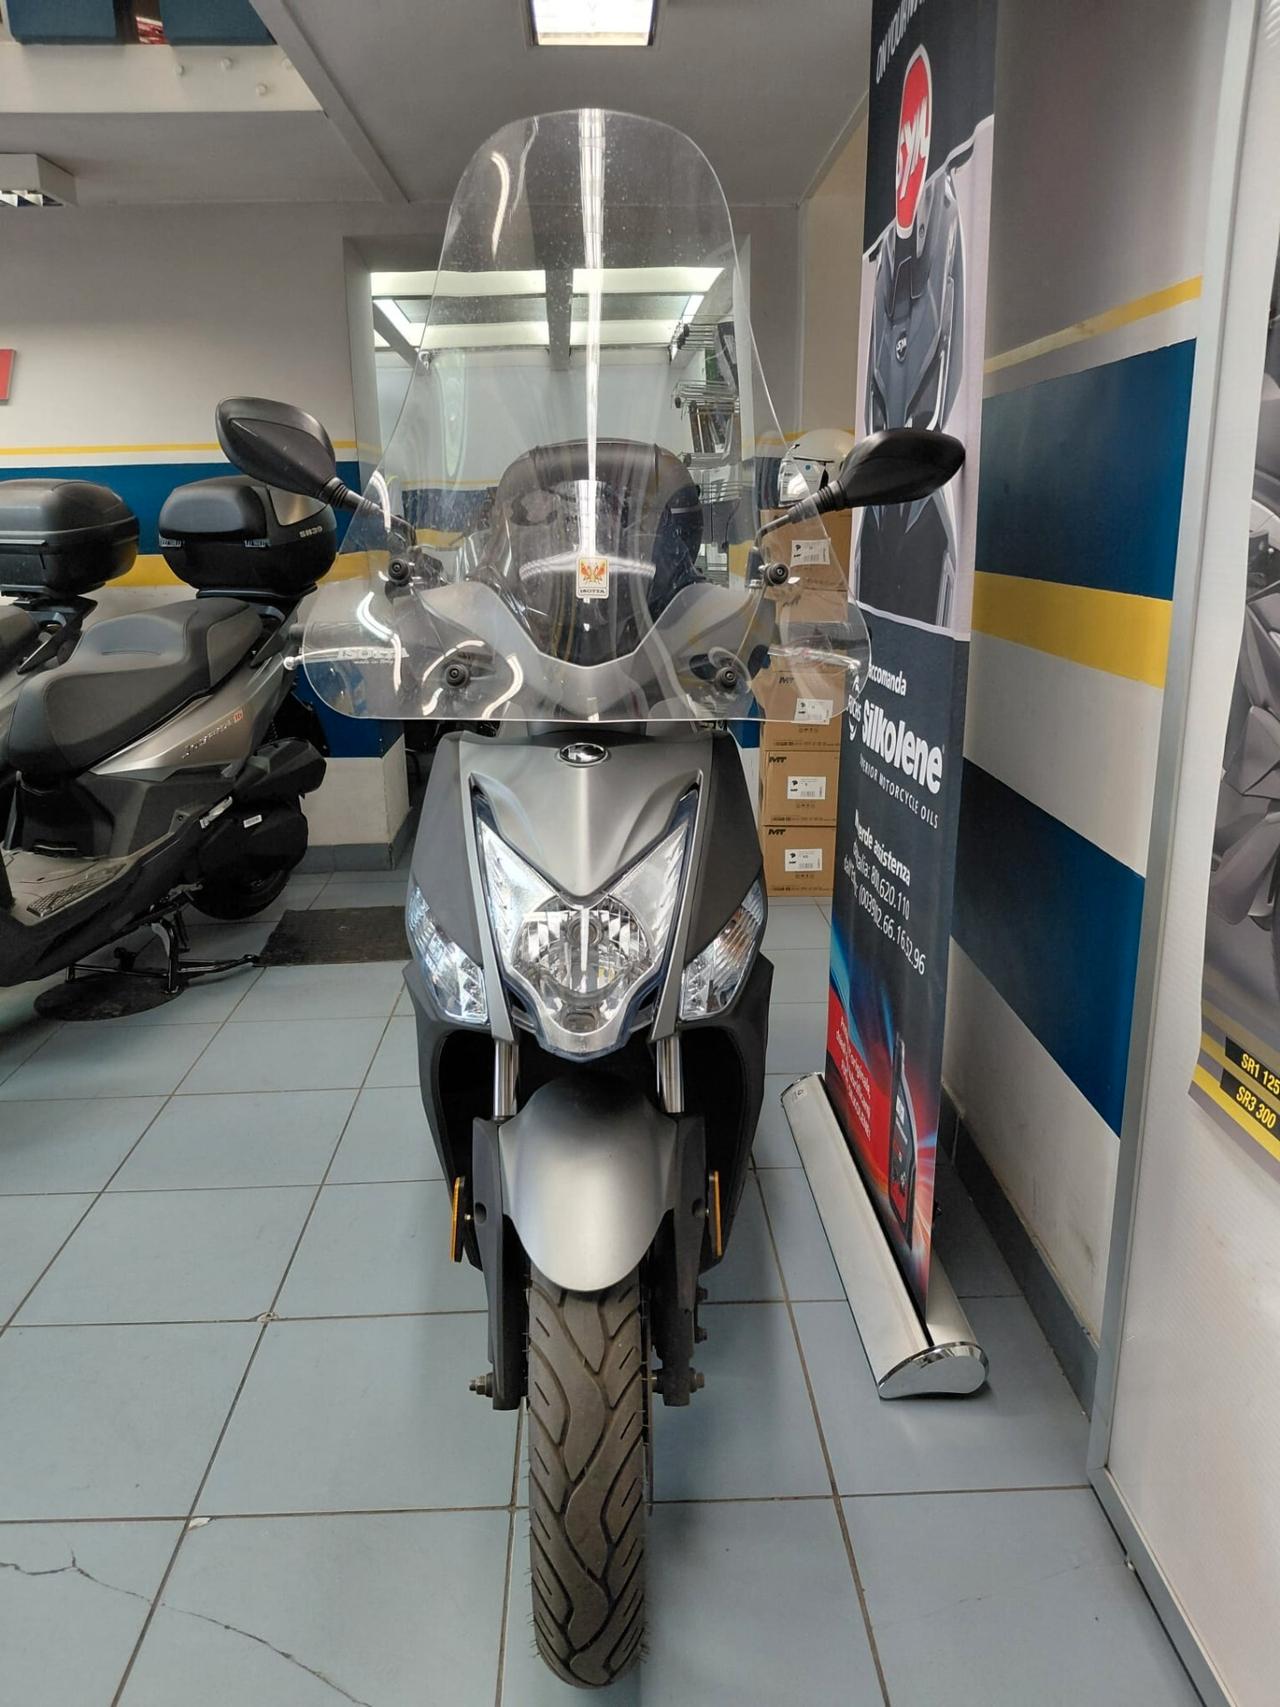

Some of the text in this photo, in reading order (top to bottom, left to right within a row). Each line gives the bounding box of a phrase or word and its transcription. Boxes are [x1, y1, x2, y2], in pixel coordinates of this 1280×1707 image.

[862, 699, 943, 794] Silkolene
[768, 828, 786, 836] MT
[920, 805, 939, 829] OILS
[1241, 1053, 1280, 1095] SR1 125
[1236, 1086, 1277, 1129] SR3 300
